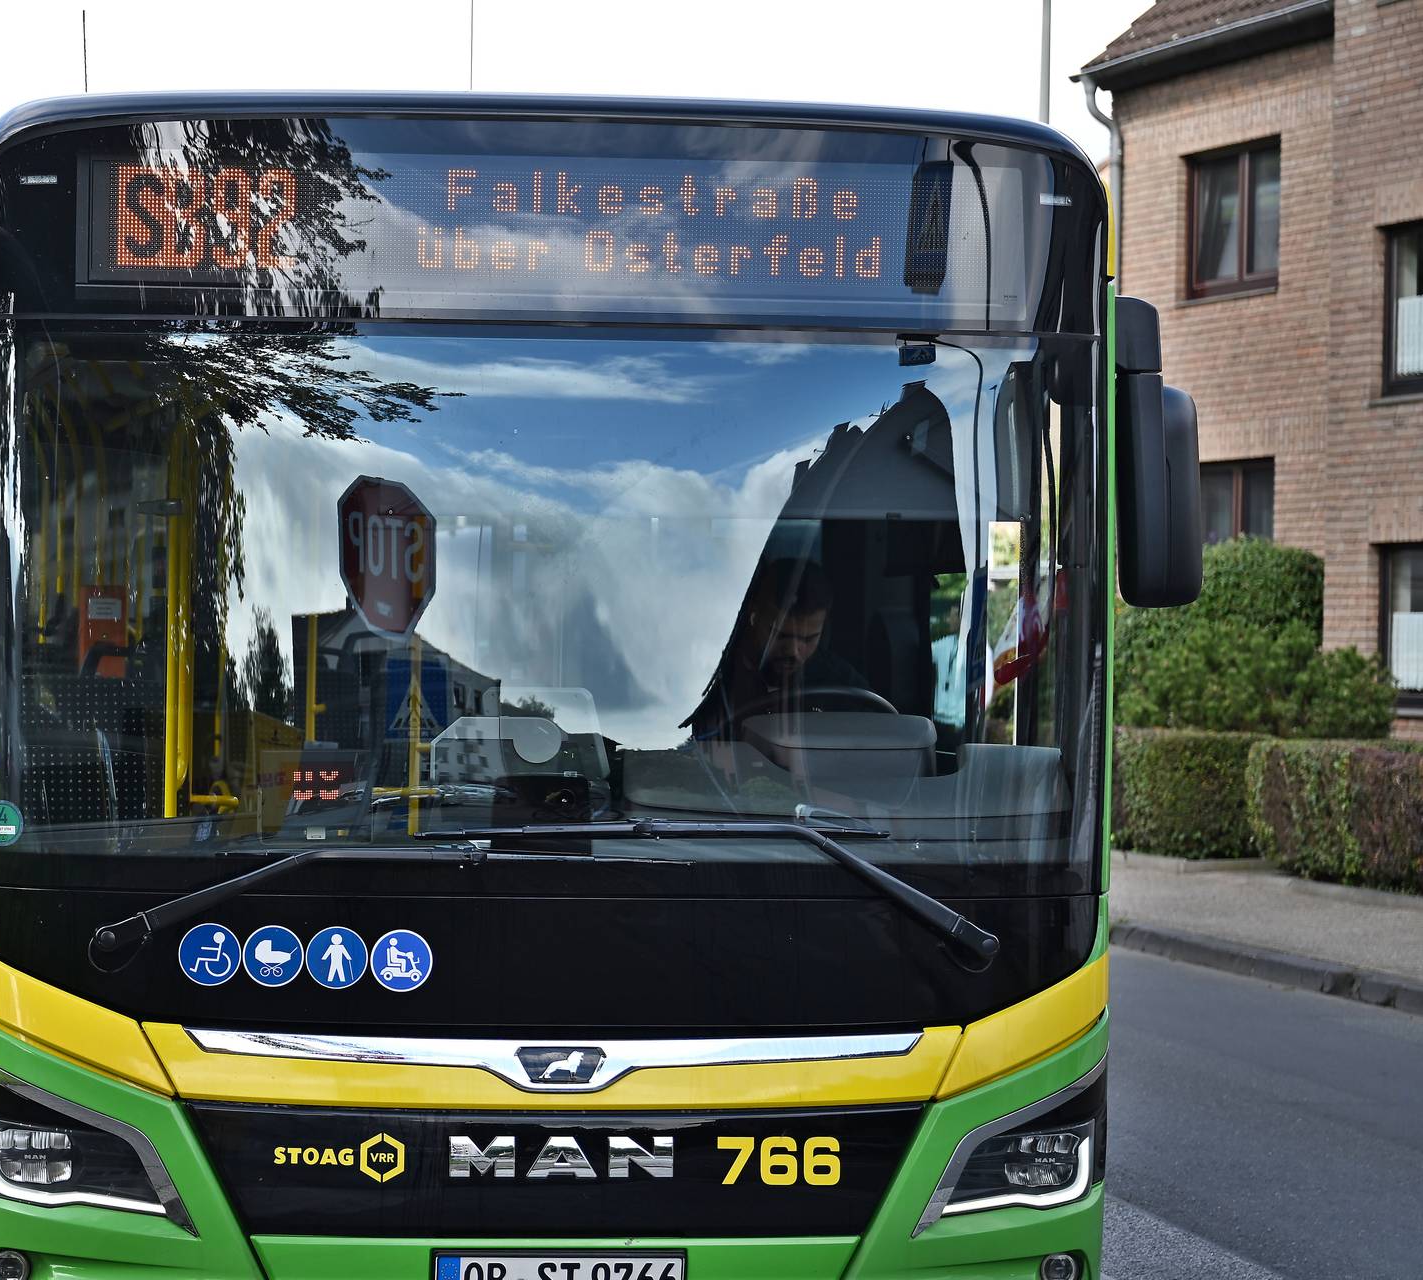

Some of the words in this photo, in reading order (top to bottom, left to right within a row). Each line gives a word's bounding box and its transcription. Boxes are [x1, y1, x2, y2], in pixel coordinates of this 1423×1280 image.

[117, 164, 298, 268] SB92
[447, 167, 858, 221] Falkestraße
[417, 226, 548, 273] über
[585, 230, 880, 279] Osterfeld
[273, 1145, 354, 1167] STOAG
[369, 1152, 395, 1164] VRR
[448, 1135, 674, 1179] MAN
[716, 1136, 841, 1186] 766
